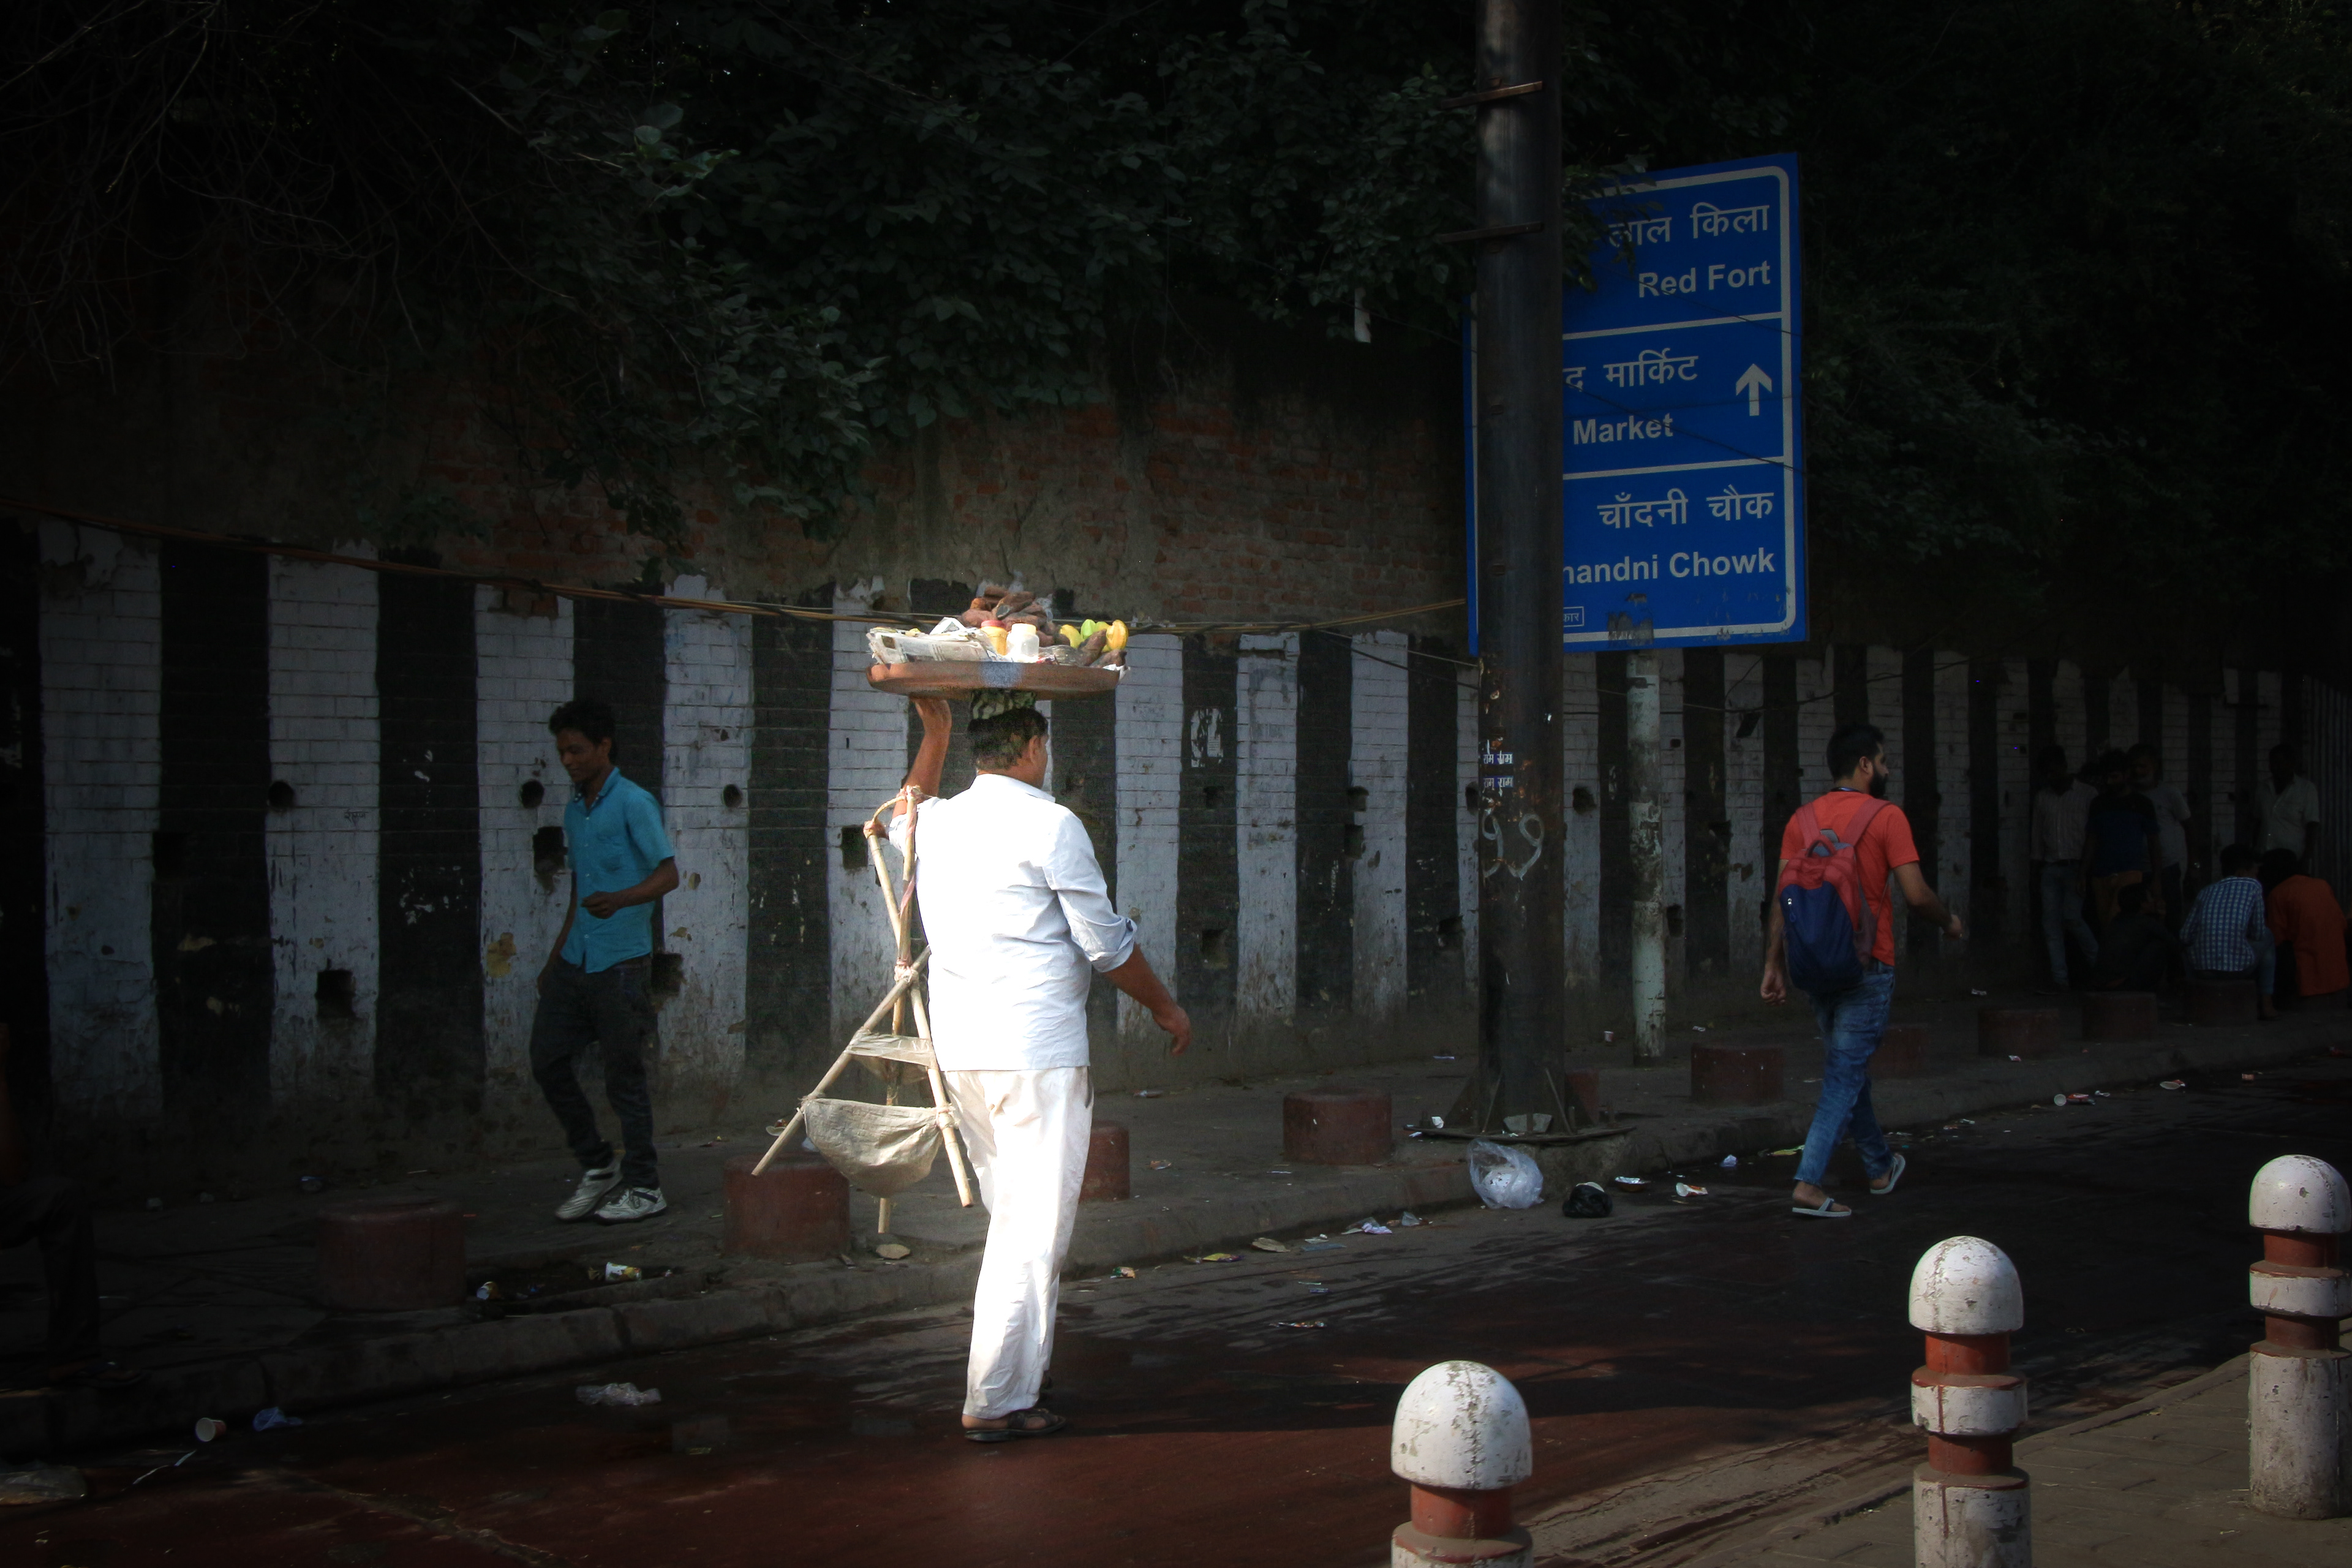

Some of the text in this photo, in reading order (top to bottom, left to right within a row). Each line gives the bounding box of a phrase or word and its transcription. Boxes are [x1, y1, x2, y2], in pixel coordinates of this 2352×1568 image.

[1608, 202, 1770, 247] लाल किला
[1638, 260, 1770, 298] Red Fort
[1604, 348, 1698, 387] मार्किट
[1573, 413, 1673, 445] Market
[1597, 484, 1774, 529] चाँदनी चौक
[1563, 548, 1775, 584] andni Chowk
[1563, 612, 1579, 622] कार
